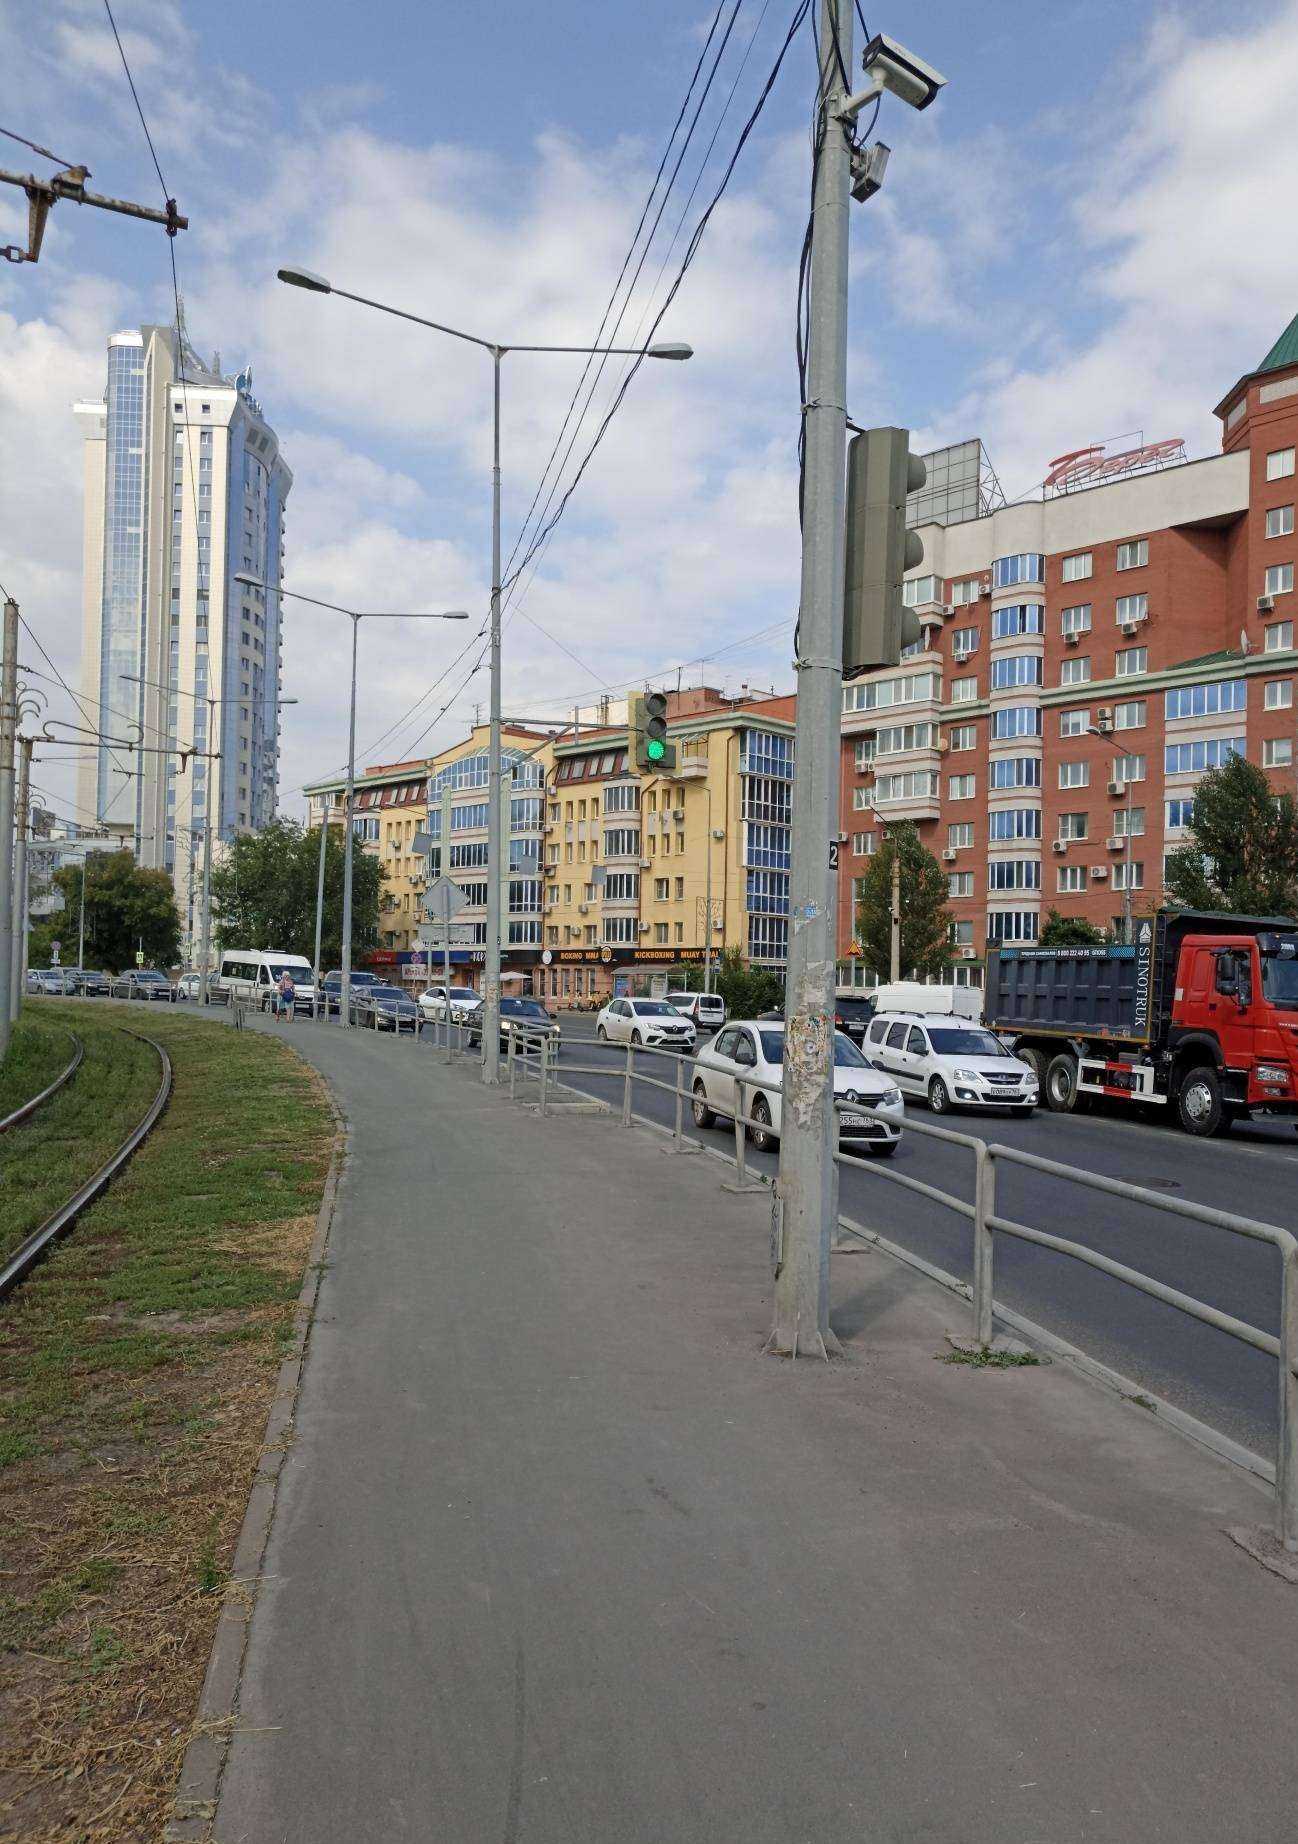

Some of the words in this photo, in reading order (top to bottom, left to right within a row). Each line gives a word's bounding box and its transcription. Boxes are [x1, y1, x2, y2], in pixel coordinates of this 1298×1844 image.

[830, 845, 838, 866] 2
[634, 951, 675, 959] KICKBOXING
[680, 951, 700, 959] MUAY
[701, 951, 719, 959] TAI
[1134, 947, 1151, 1027] SINOTRUK
